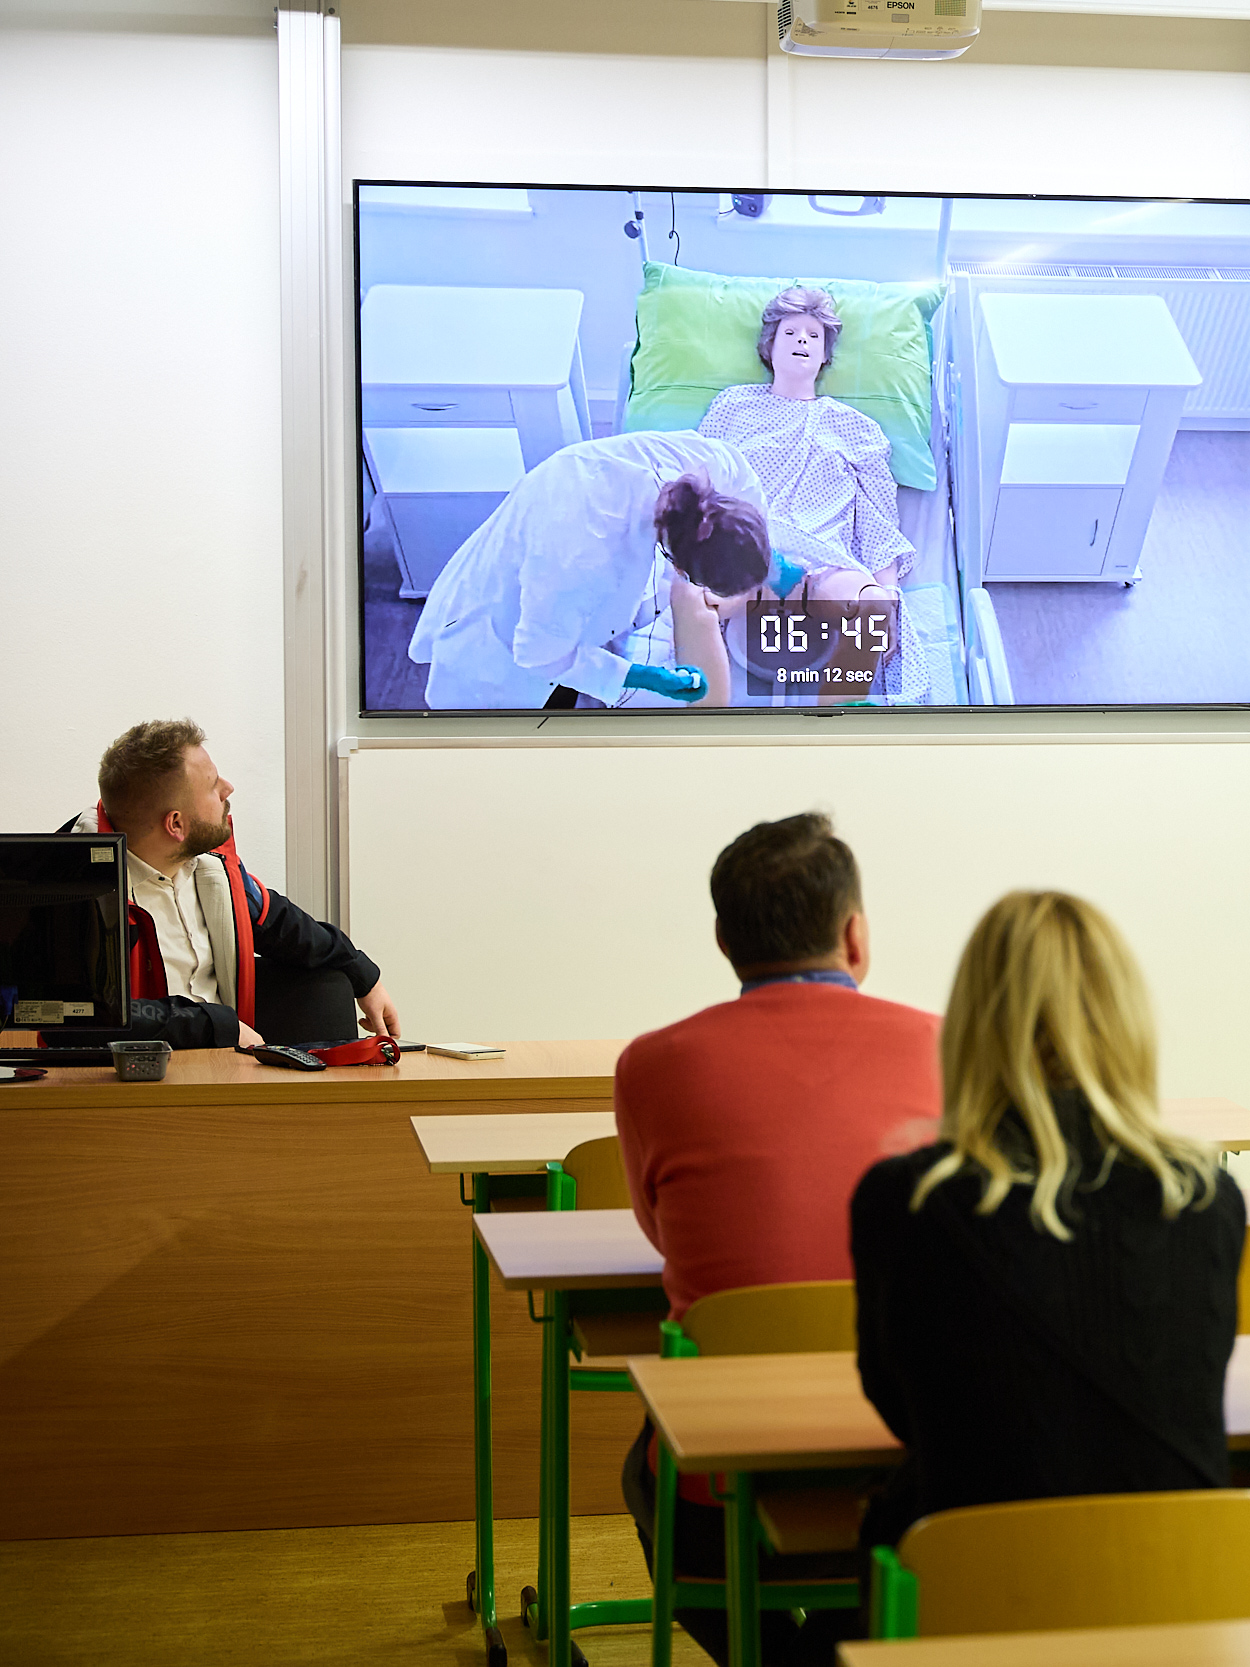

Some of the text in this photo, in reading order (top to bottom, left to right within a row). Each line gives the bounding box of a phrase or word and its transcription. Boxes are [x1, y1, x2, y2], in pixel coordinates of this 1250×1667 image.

[887, 1, 915, 9] EPSON
[760, 614, 889, 652] 06:45
[777, 667, 874, 683] 8 min 12 sec
